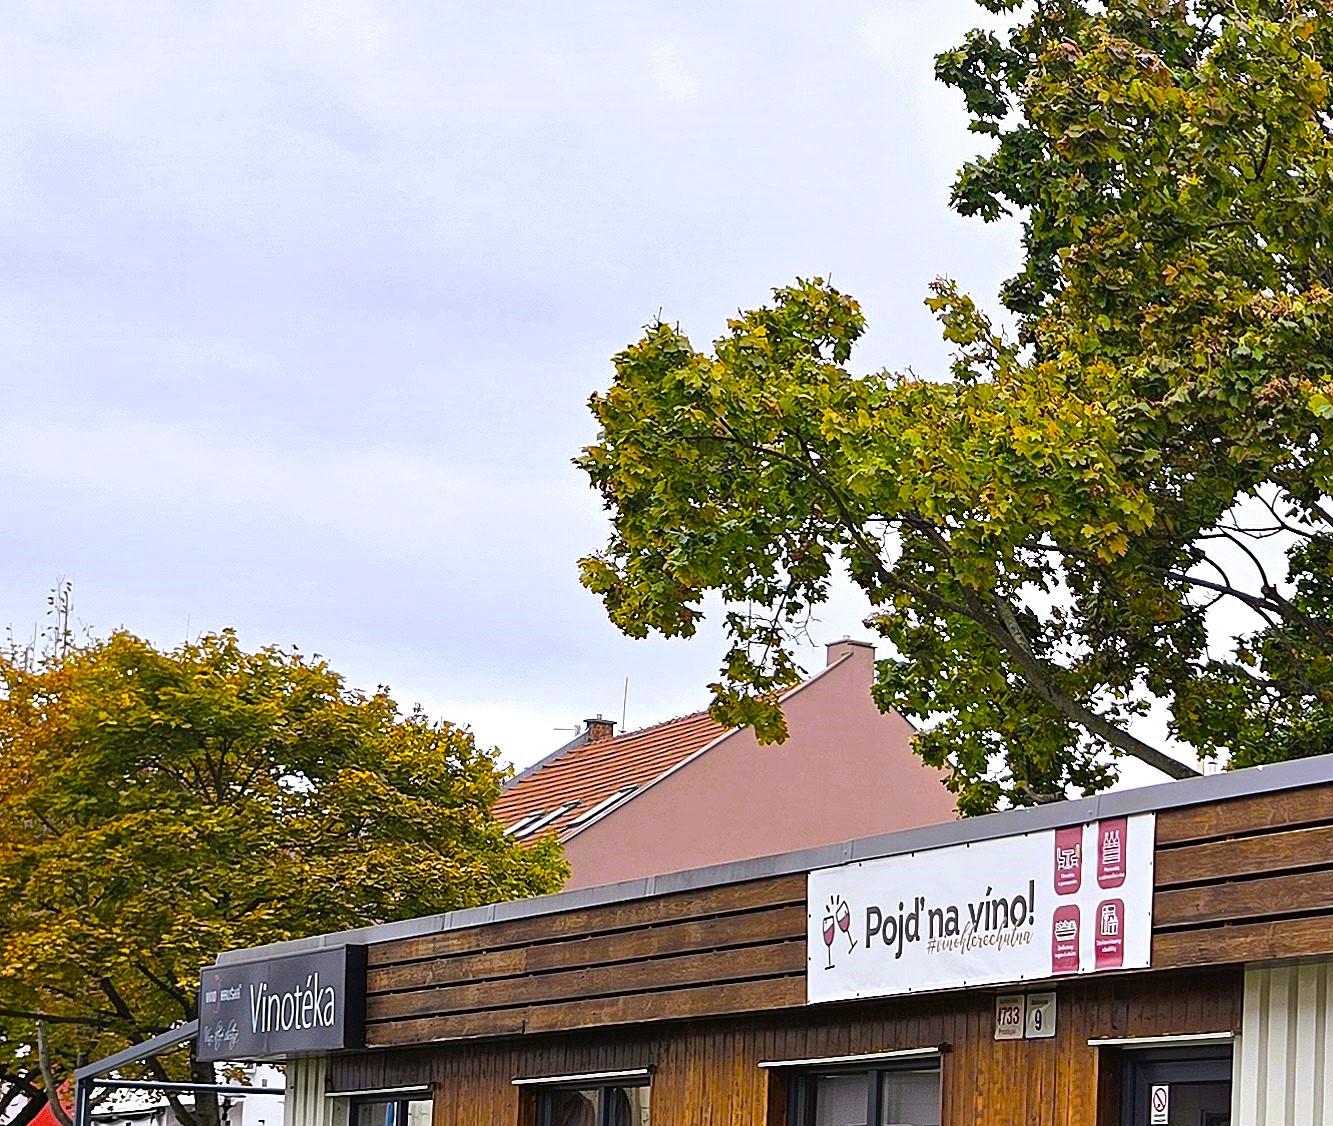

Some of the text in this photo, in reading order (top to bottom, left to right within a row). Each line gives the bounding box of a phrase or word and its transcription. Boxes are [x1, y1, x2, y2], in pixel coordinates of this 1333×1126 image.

[865, 879, 1035, 960] Pojď na víno!
[250, 972, 336, 1034] Vinotéka
[1034, 1009, 1043, 1032] 9
